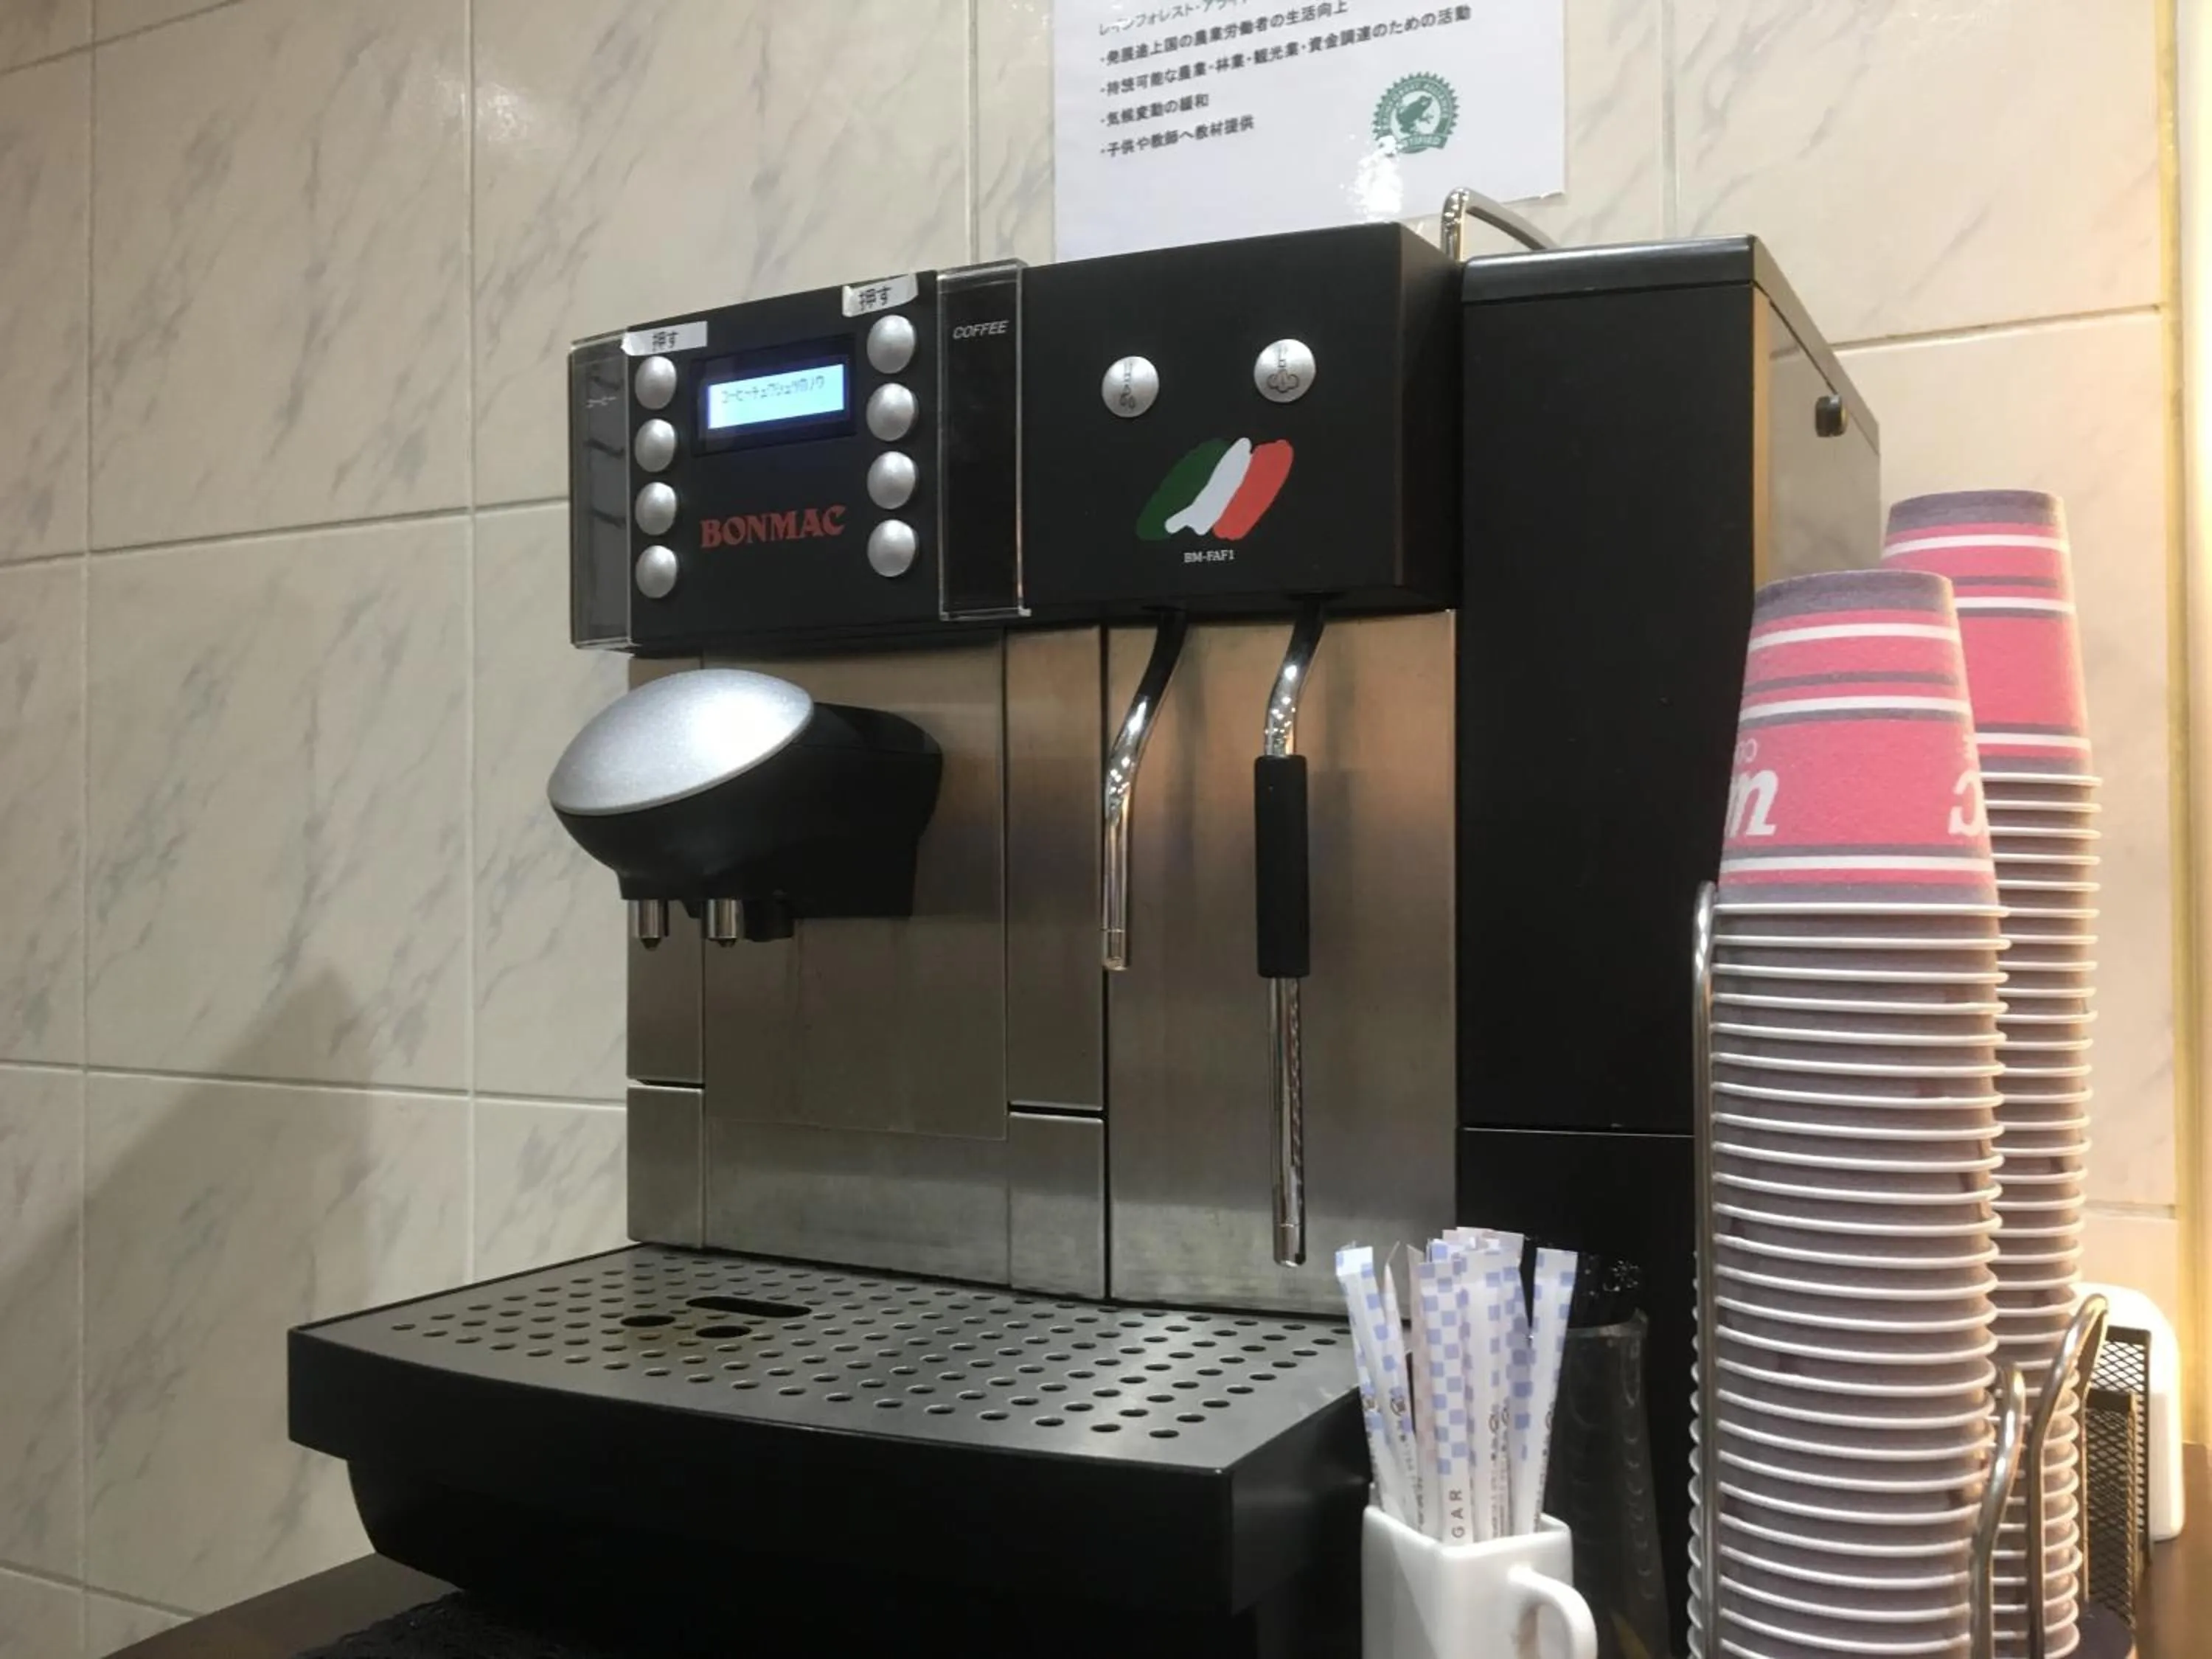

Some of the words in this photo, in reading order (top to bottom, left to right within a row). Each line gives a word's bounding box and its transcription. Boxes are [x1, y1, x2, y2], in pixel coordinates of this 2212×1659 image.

[953, 320, 1010, 340] COFFEE
[700, 504, 846, 549] BONMAC
[1183, 549, 1235, 563] BM-FAF1
